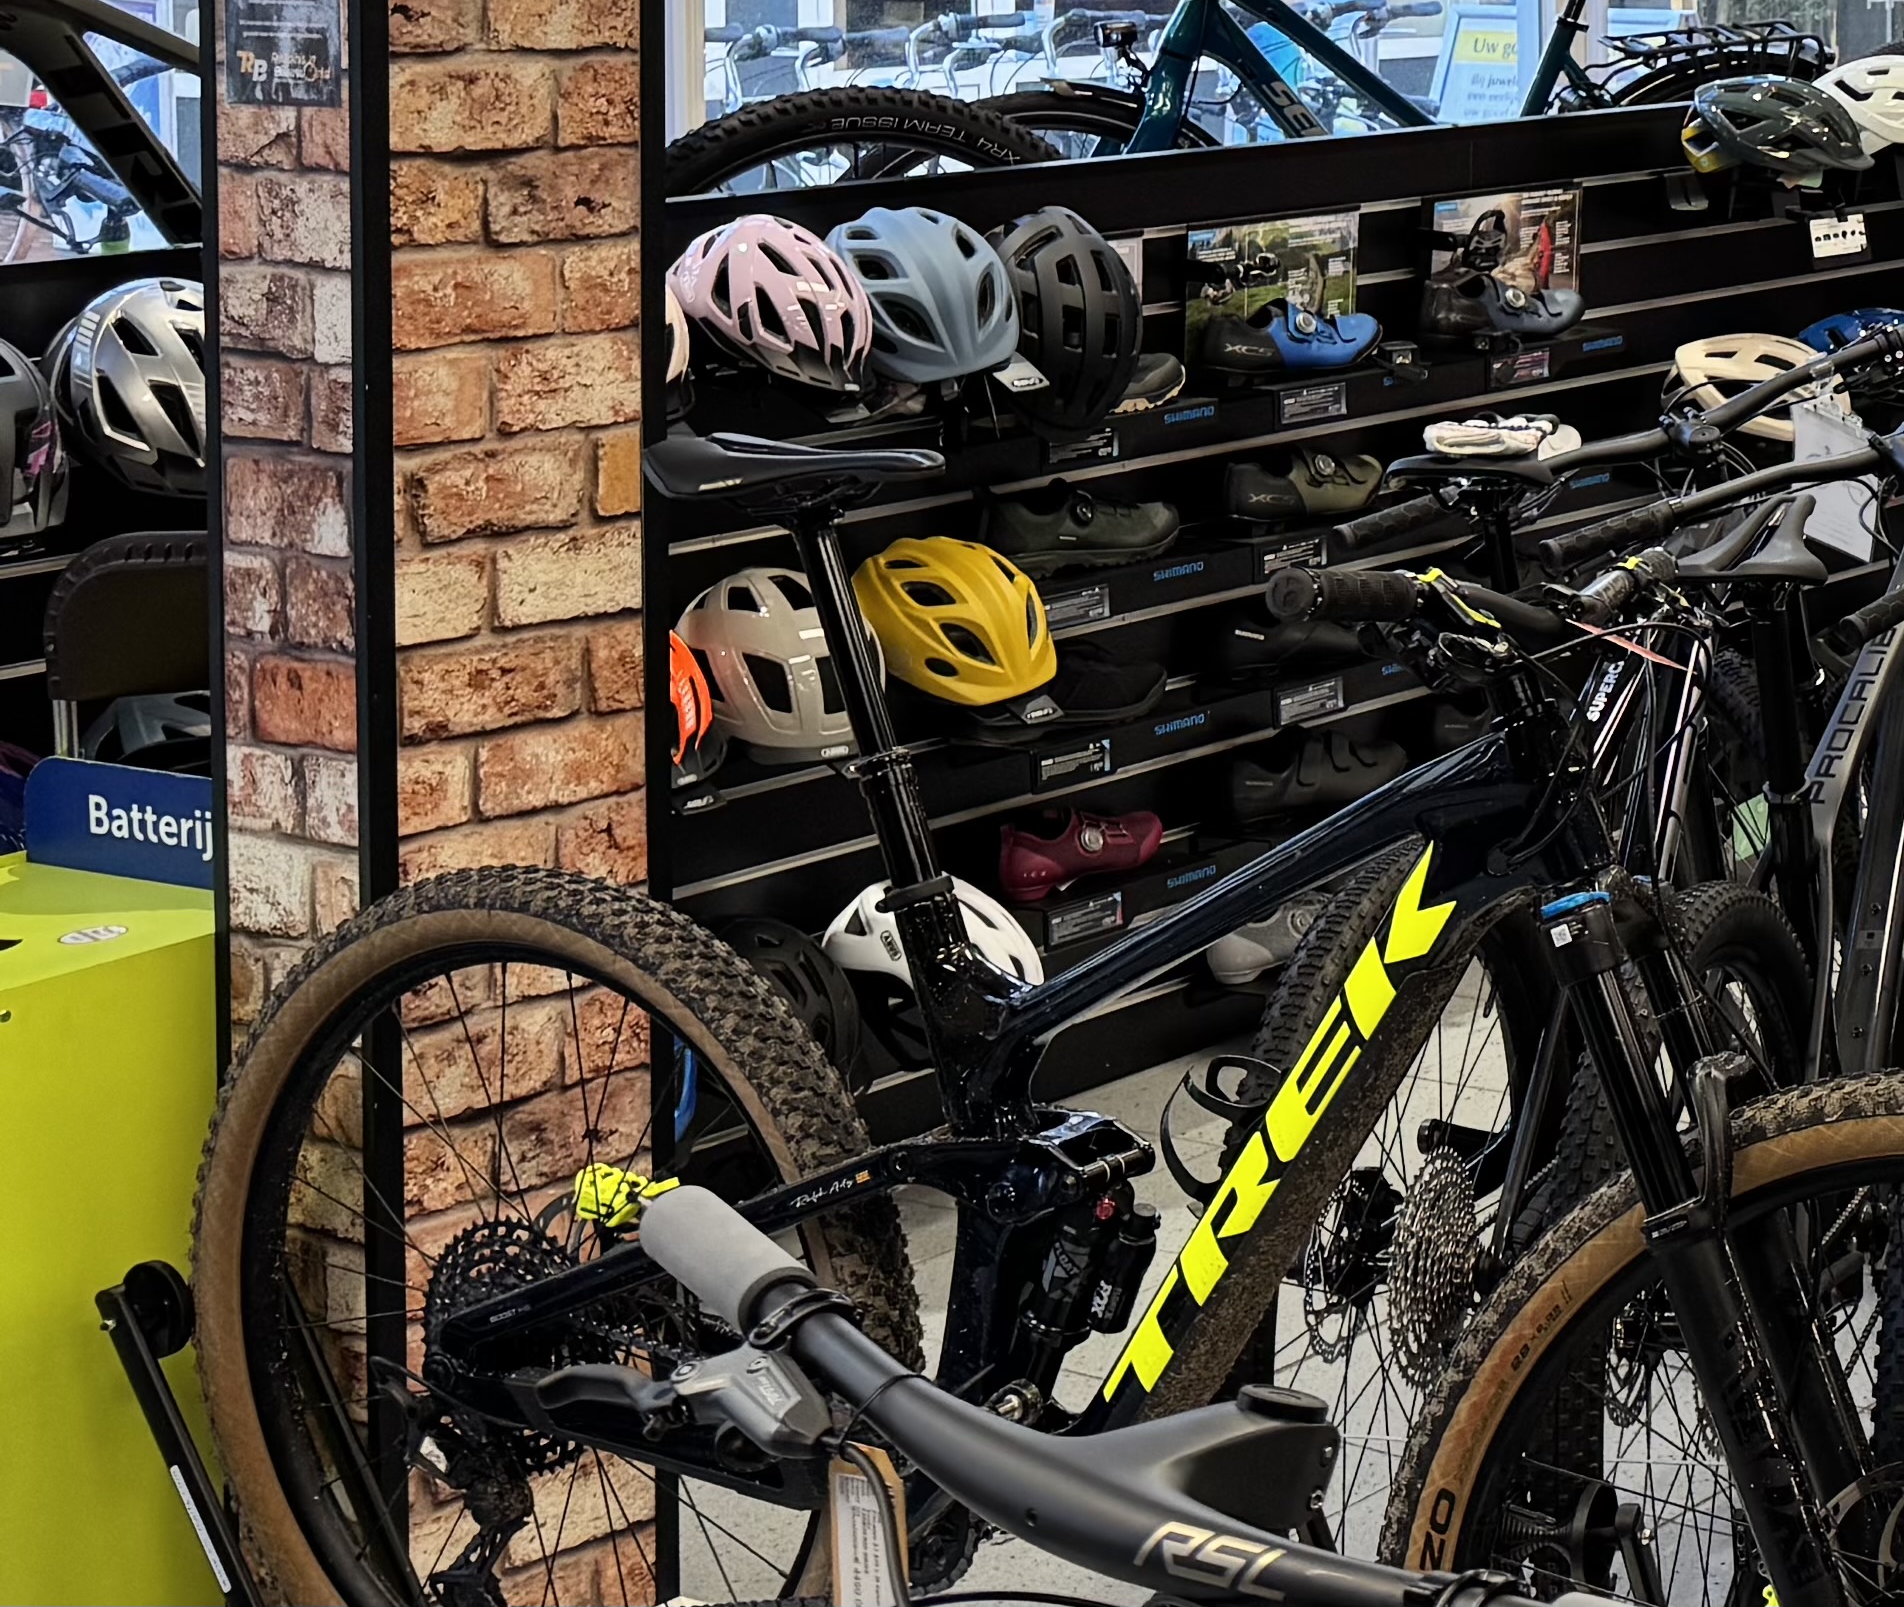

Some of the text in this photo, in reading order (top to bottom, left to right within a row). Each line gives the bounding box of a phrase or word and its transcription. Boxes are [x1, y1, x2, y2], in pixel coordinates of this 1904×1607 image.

[1474, 37, 1498, 55] Uw
[831, 116, 1021, 166] XR4 TEAM ISSUE
[1164, 405, 1215, 424] SHIMANO
[1153, 561, 1204, 581] SHIMANO
[1154, 714, 1205, 735] SHIMANO
[88, 794, 213, 863] Batterij
[1167, 864, 1216, 888] SHIMANO
[1103, 841, 1456, 1403] TREK
[1133, 1521, 1288, 1601] RSL
